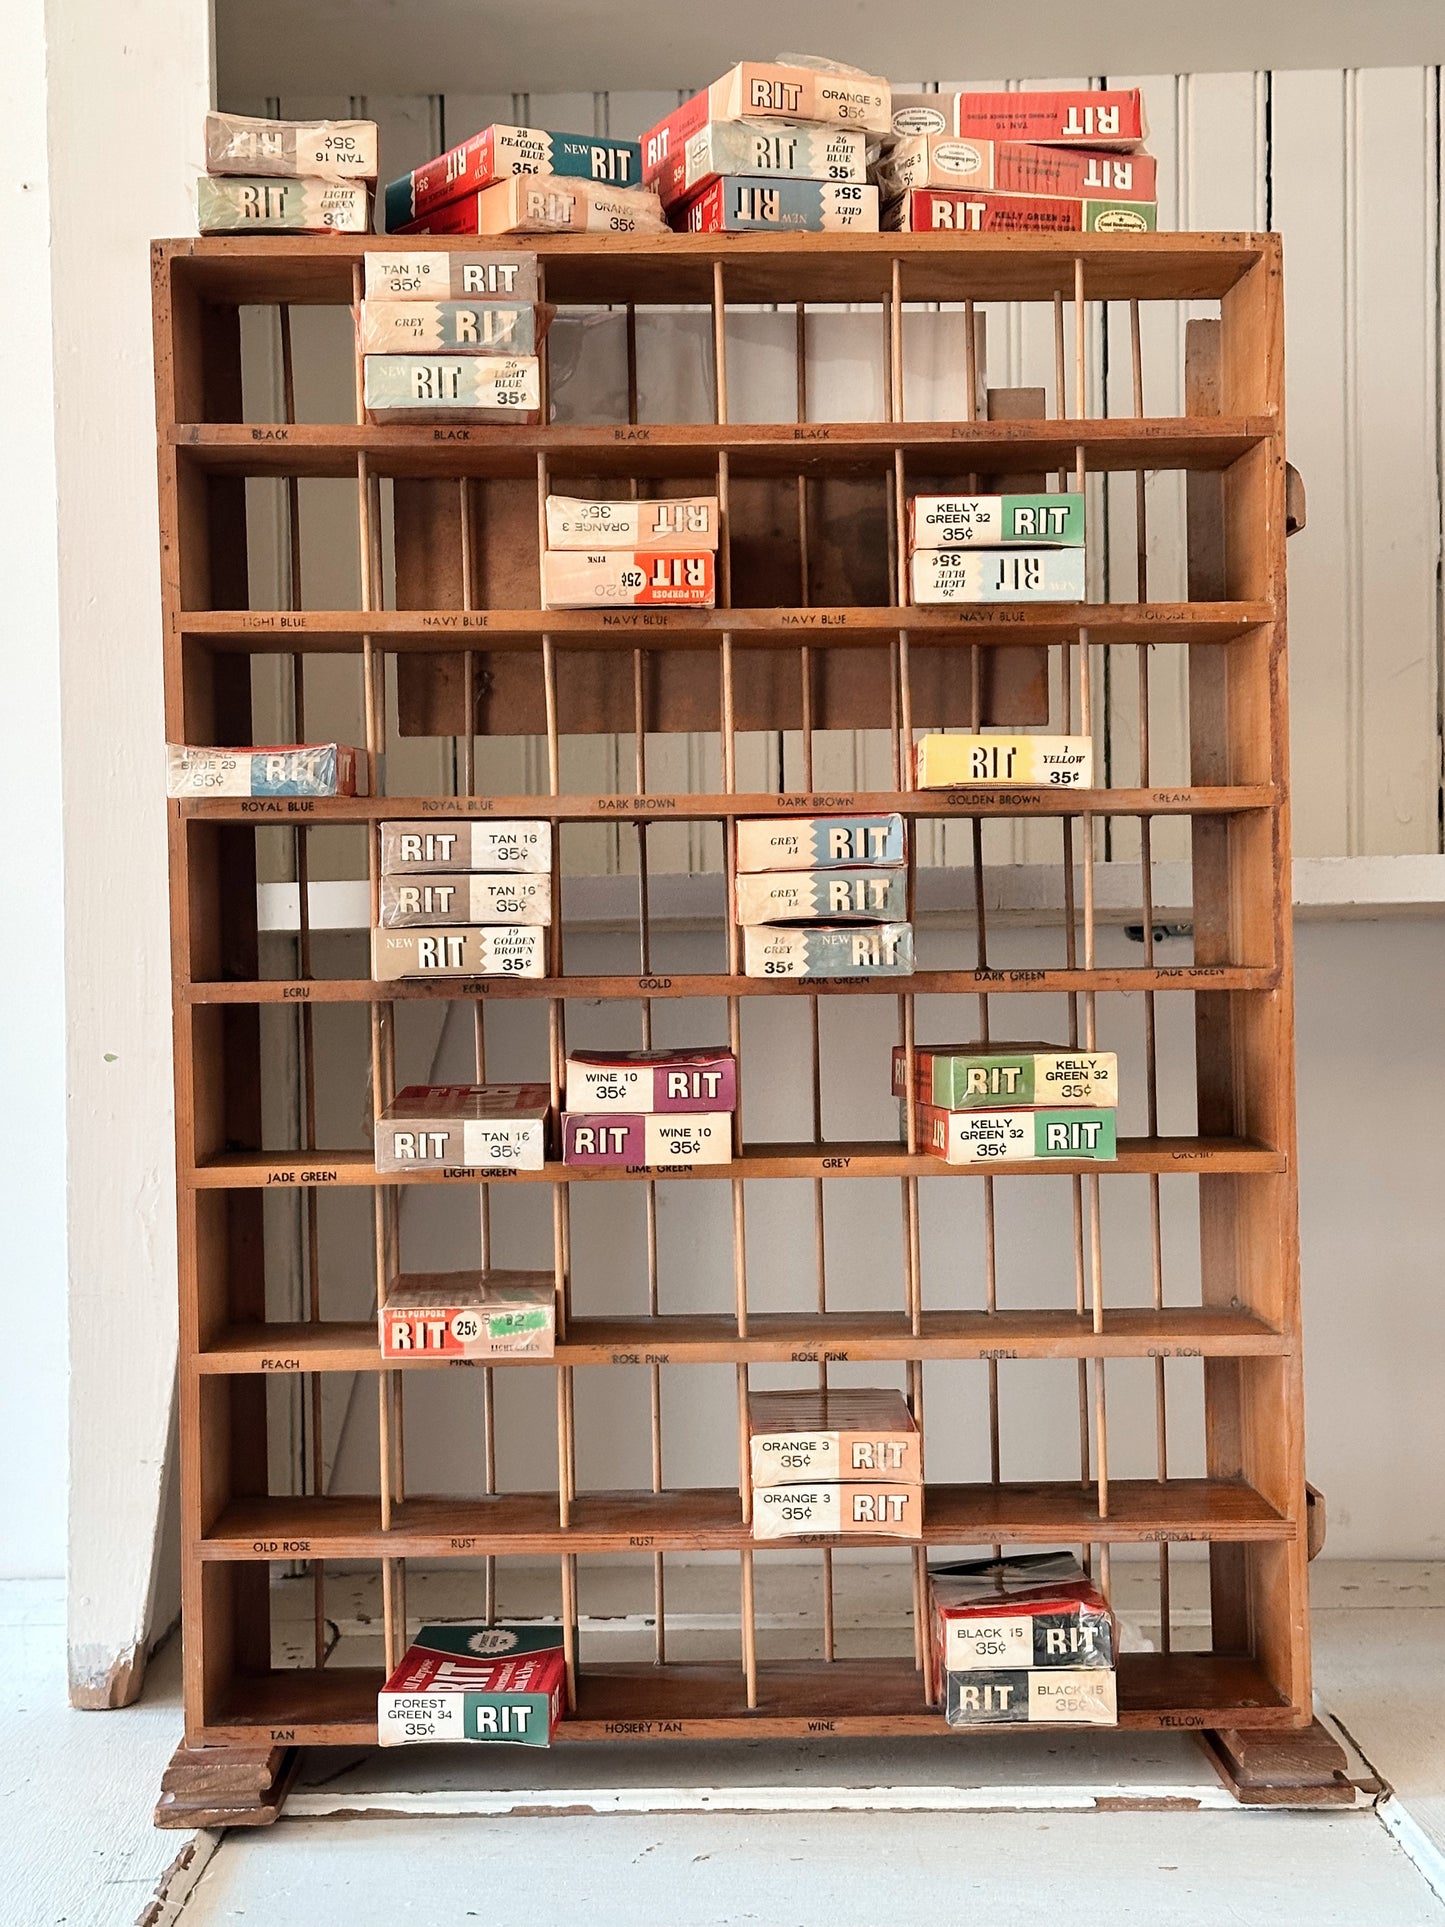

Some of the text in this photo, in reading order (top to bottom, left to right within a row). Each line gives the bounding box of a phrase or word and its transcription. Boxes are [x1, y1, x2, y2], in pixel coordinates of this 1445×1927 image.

[751, 79, 802, 110] RIT
[1062, 106, 1119, 134] RIT
[325, 137, 356, 149] 35¢
[500, 137, 545, 151] PEACOCK
[648, 128, 669, 167] RIT
[756, 137, 797, 170] RIT
[826, 145, 855, 154] LIGHT
[316, 152, 364, 163] TAN 16
[520, 150, 545, 161] BLUE
[827, 154, 852, 162] BLUE
[446, 147, 466, 183] RIT
[564, 143, 633, 181] NEW RIT
[512, 163, 539, 175] 35¢
[1083, 159, 1134, 190] RIT
[239, 186, 289, 218] RIT
[527, 191, 576, 223] RIT
[734, 187, 781, 222] RIT
[931, 200, 987, 230] RIT
[382, 264, 431, 275] TAN 16
[461, 264, 519, 293] RIT
[390, 277, 422, 292] 35¢
[395, 318, 424, 327] GREY
[455, 310, 518, 344] RIT
[495, 380, 523, 389] BLUE
[252, 430, 288, 439] BLACK
[434, 430, 470, 440] BLACK
[614, 430, 650, 439] BLACK
[794, 430, 830, 439] BLACK
[580, 505, 611, 519] 35¢
[937, 503, 979, 512] KELLY
[652, 505, 709, 533] RIT
[926, 513, 991, 524] GREEN 32
[1013, 507, 1070, 535] RIT
[587, 555, 607, 564] PINK
[928, 554, 961, 567] 35¢
[650, 558, 705, 587] RIT
[938, 570, 966, 578] BLUE
[621, 572, 642, 587] 25¢
[934, 580, 966, 588] LIGHT
[652, 590, 706, 599] ALL PURPOSE
[423, 616, 488, 626] NAVY BLUE
[603, 615, 668, 625] NAVY BLUE
[782, 614, 846, 624] NAVY BLUE
[959, 611, 1025, 621] NAVY BLUE
[970, 746, 1018, 779] RIT
[1043, 755, 1085, 764] YELLOW
[1050, 771, 1080, 784] 35¢
[598, 799, 676, 809] DARK BROWN
[777, 797, 855, 807] DARK BROWN
[947, 795, 1041, 805] GOLDEN BROWN
[242, 802, 315, 812] ROYAL BLUE
[422, 801, 495, 811] ROYAL BLUE
[489, 834, 538, 844] TAN 16
[770, 836, 799, 845] GREY
[829, 827, 892, 859] RIT
[400, 833, 457, 862] RIT
[488, 886, 536, 896] TAN 16
[770, 889, 799, 898] GREY
[829, 879, 893, 911] RIT
[399, 886, 456, 913] RIT
[496, 899, 527, 912] 35¢
[494, 937, 536, 946] GOLDEN
[494, 946, 534, 956] BROWN
[822, 934, 902, 967] NEW RIT
[764, 961, 794, 975] 35¢
[799, 975, 870, 985] DARK GREEN
[975, 971, 1046, 981] DARK GREEN
[463, 984, 490, 994] ECRU
[639, 979, 672, 989] GOLD
[283, 987, 310, 998] ECRU
[1056, 1060, 1097, 1070] KELLY
[586, 1073, 638, 1082] WINE 10
[965, 1066, 1023, 1095] RIT
[1045, 1070, 1109, 1081] GREEN 32
[666, 1071, 723, 1099] RIT
[1061, 1084, 1092, 1098] 35¢
[971, 1119, 1013, 1129] KELLY
[659, 1128, 712, 1138] WINE 10
[960, 1129, 1024, 1140] GREEN 32
[1046, 1121, 1103, 1151] RIT
[394, 1131, 450, 1160] RIT
[574, 1126, 631, 1155] RIT
[670, 1140, 701, 1154] 35¢
[626, 1164, 693, 1174] LIME GREEN
[822, 1158, 851, 1169] GREY
[267, 1172, 337, 1184] JADE GREEN
[443, 1168, 517, 1178] LIGHT GREEN
[392, 1310, 446, 1319] ALL PURPOSE
[391, 1321, 478, 1350] RIT 25¢
[791, 1352, 849, 1361] ROSE PINK
[980, 1349, 1018, 1359] PURPLE
[1147, 1347, 1204, 1358] OLD ROSE
[261, 1359, 300, 1369] PEACH
[612, 1354, 670, 1364] ROSE PINK
[762, 1442, 830, 1452] ORANGE 3
[852, 1441, 908, 1469] RIT
[780, 1455, 811, 1469] 35¢
[763, 1494, 831, 1504] ORANGE 3
[853, 1494, 909, 1522] RIT
[253, 1541, 311, 1552] OLD ROSE
[451, 1538, 477, 1548] RUST
[629, 1536, 655, 1546] RUST
[957, 1628, 1023, 1639] BLACK 15
[1046, 1627, 1099, 1656] RIT
[975, 1641, 1006, 1655] 35¢
[960, 1684, 1014, 1710] RIT
[394, 1699, 446, 1709] FOREST
[388, 1710, 452, 1720] GREEN 34
[476, 1705, 533, 1733] RIT
[808, 1721, 835, 1731] WINE
[1159, 1716, 1205, 1727] YELLOW
[605, 1722, 683, 1733] HOSIERY TAN
[270, 1731, 294, 1740] TAN
